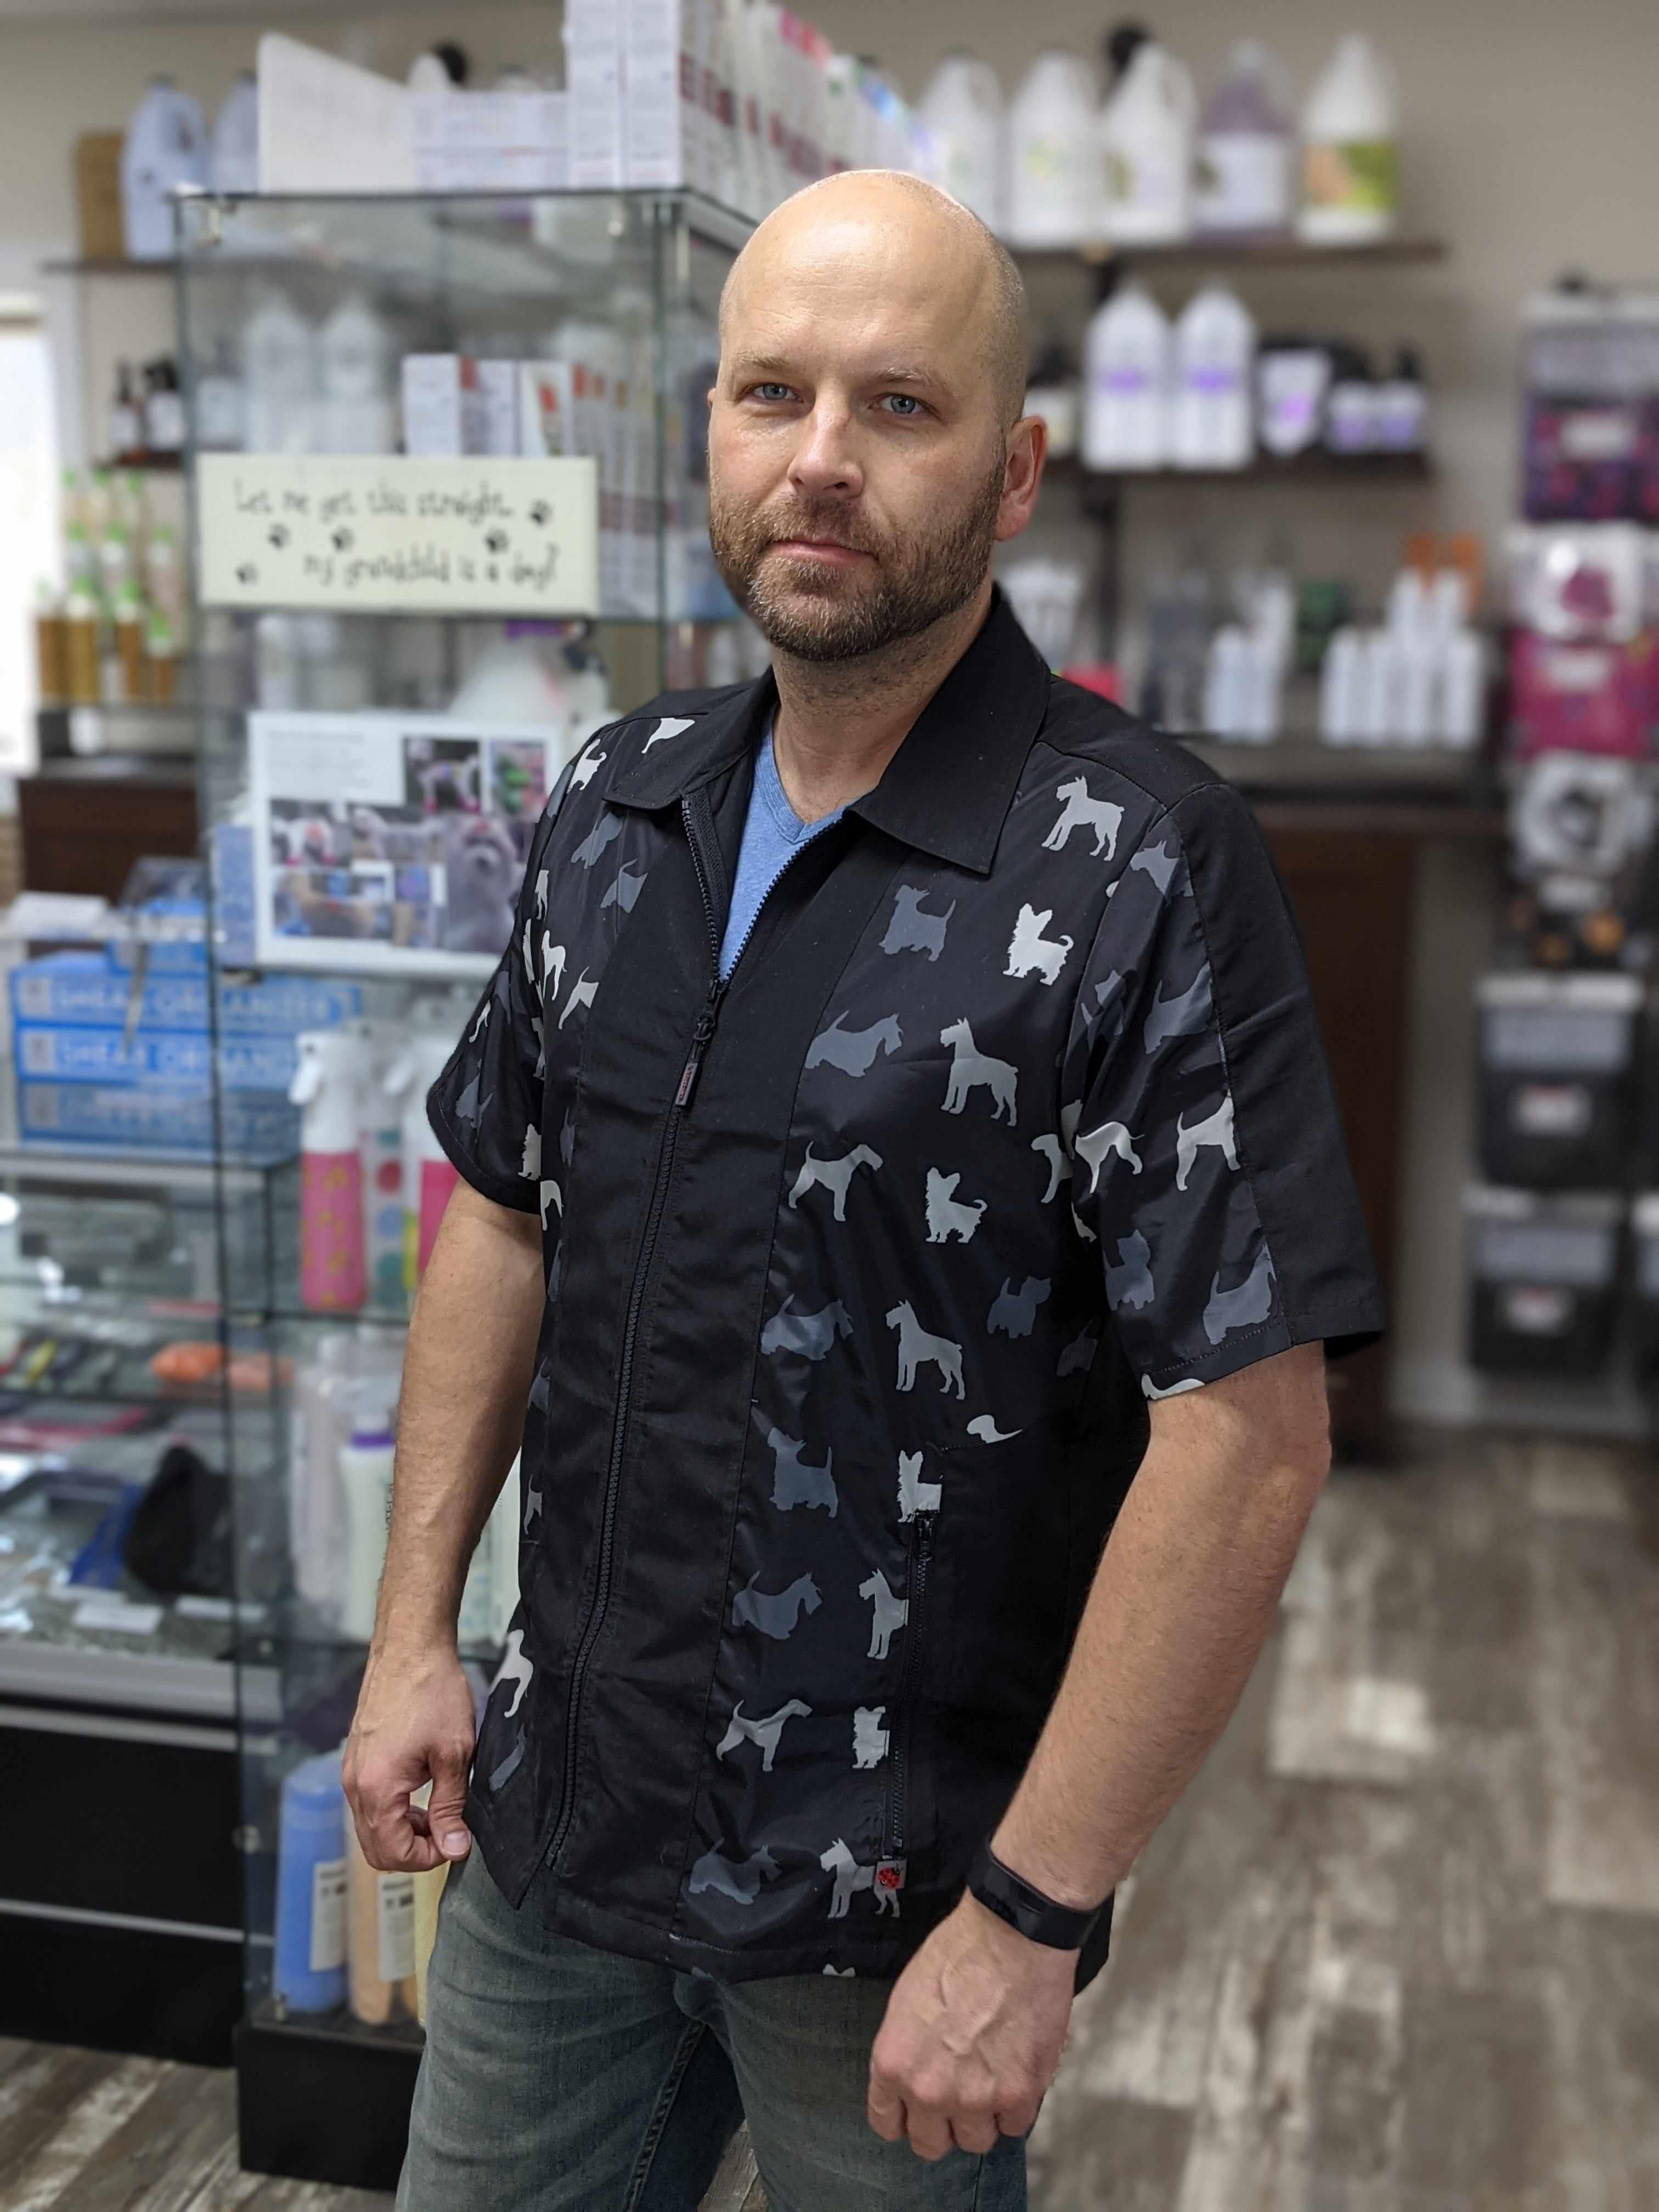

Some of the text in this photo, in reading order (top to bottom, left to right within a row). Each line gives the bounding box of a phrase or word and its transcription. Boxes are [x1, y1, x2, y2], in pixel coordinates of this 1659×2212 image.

[235, 477, 273, 514] Let
[281, 488, 309, 514] me
[319, 488, 358, 524] get
[366, 479, 408, 515] this
[487, 562, 499, 583] a
